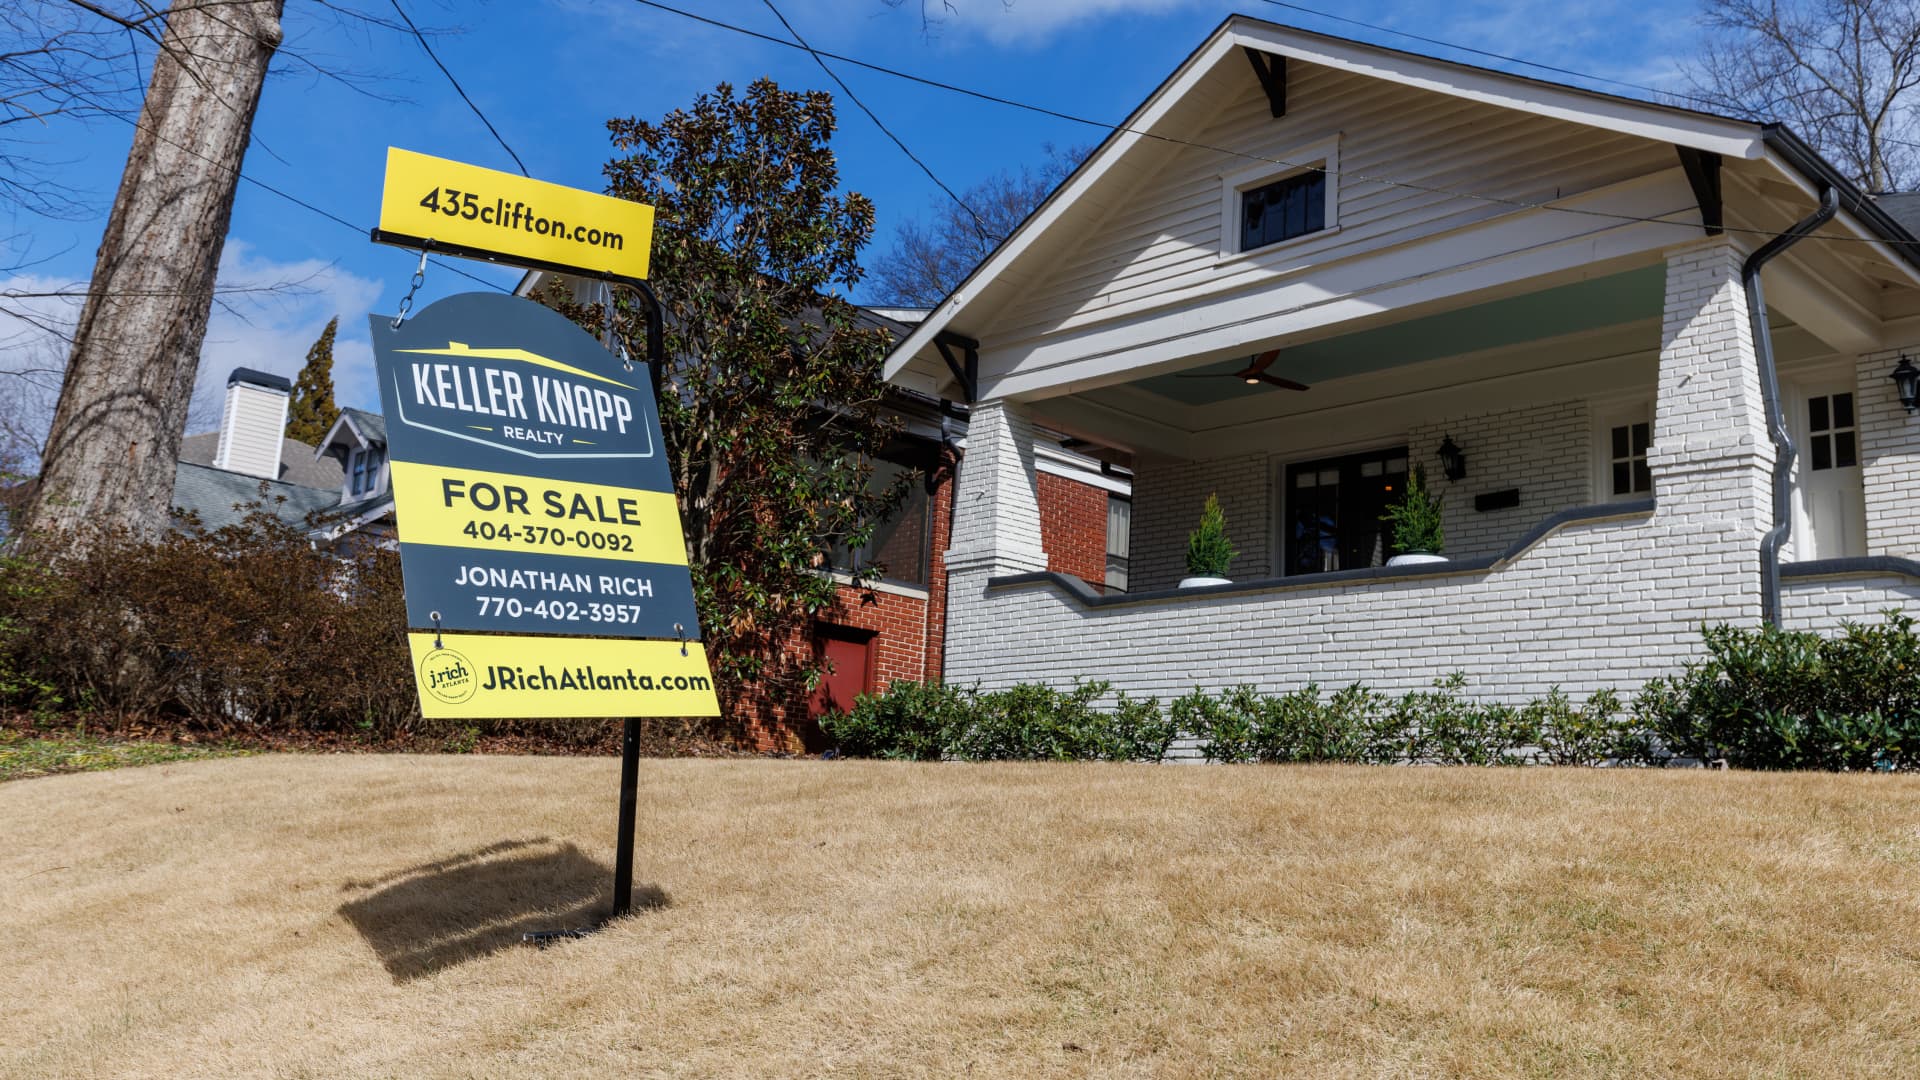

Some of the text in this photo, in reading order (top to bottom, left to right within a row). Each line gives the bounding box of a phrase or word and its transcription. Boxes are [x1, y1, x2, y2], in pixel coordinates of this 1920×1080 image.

[419, 186, 624, 250] 435clifton.com
[411, 363, 632, 434] KELLER KNAPP
[504, 425, 564, 445] REALTY
[441, 478, 641, 526] FOR SALE
[463, 520, 634, 552] 404-370-0092
[455, 566, 653, 597] JONATHAN RICH
[476, 596, 641, 624] 770-402-3957
[429, 661, 469, 689] j.rich
[442, 678, 469, 688] ATLANTA
[482, 665, 710, 691] JRichAtlanta.com
